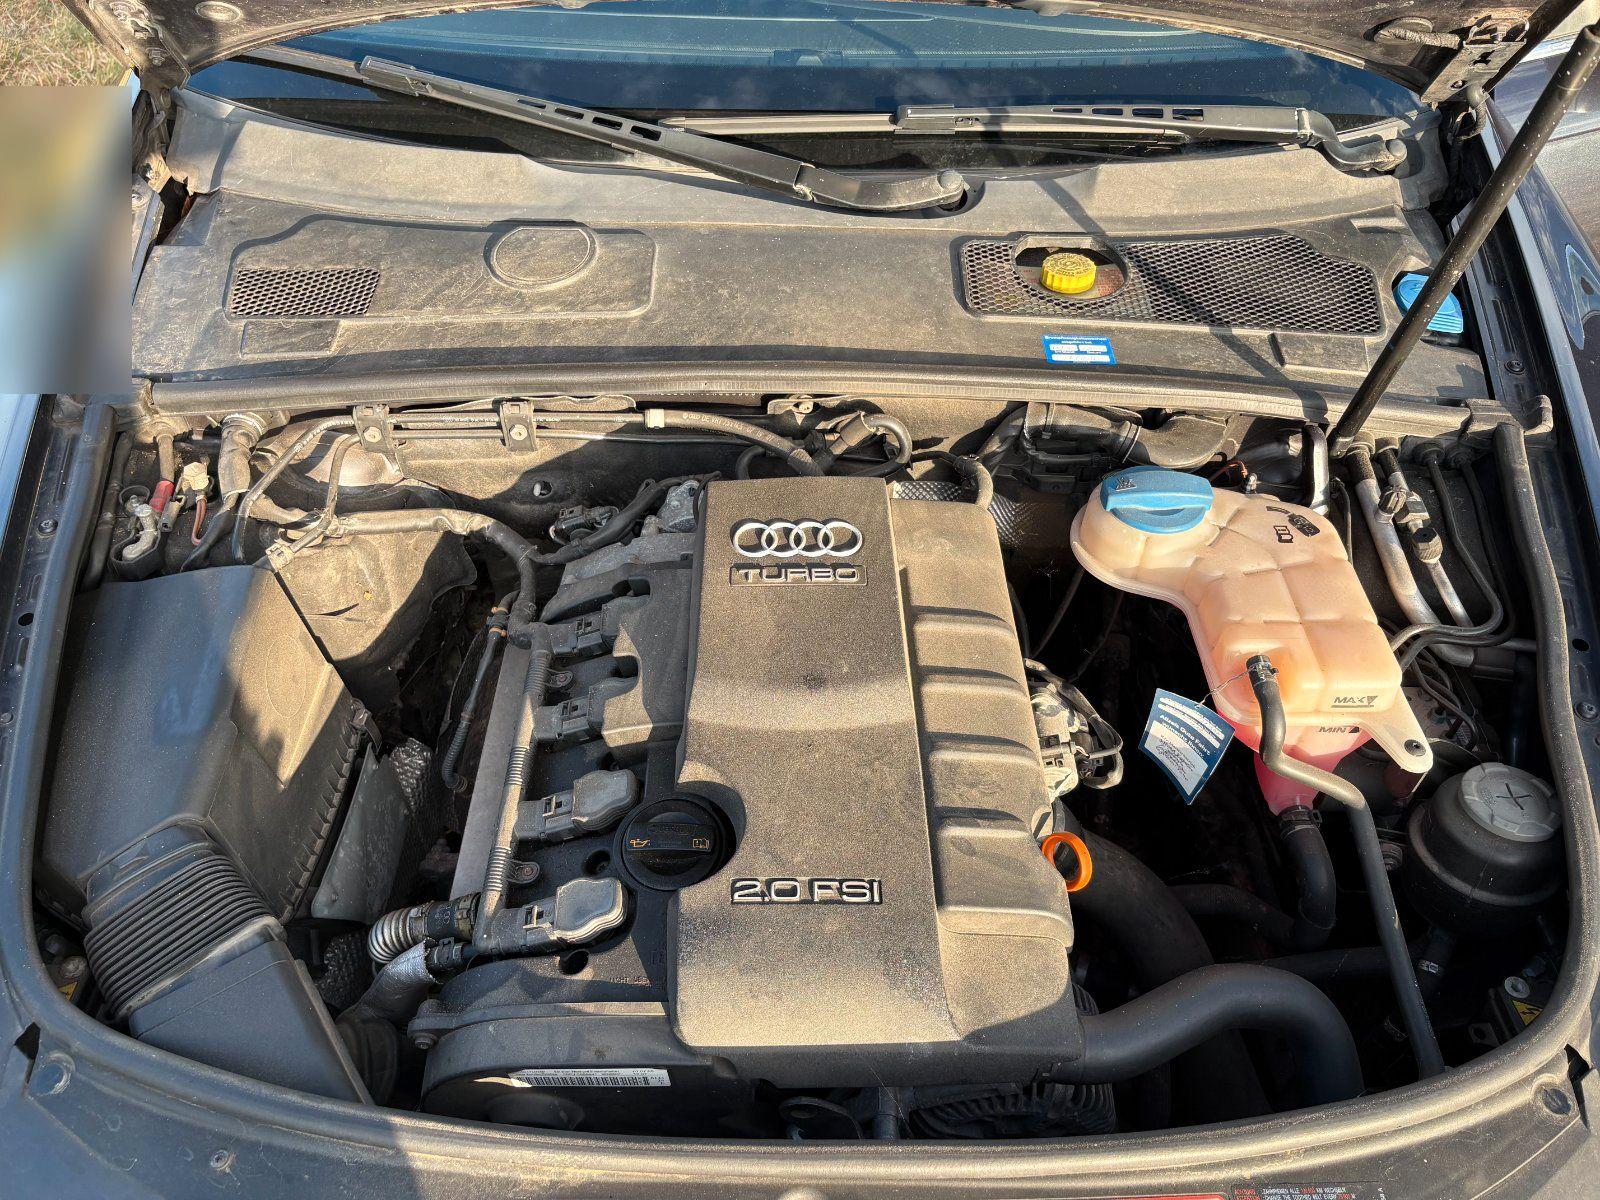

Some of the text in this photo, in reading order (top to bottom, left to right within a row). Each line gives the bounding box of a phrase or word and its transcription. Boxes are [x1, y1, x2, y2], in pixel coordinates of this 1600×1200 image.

[736, 565, 859, 582] TURBO
[1334, 696, 1366, 704] MAX
[812, 879, 881, 903] FSI
